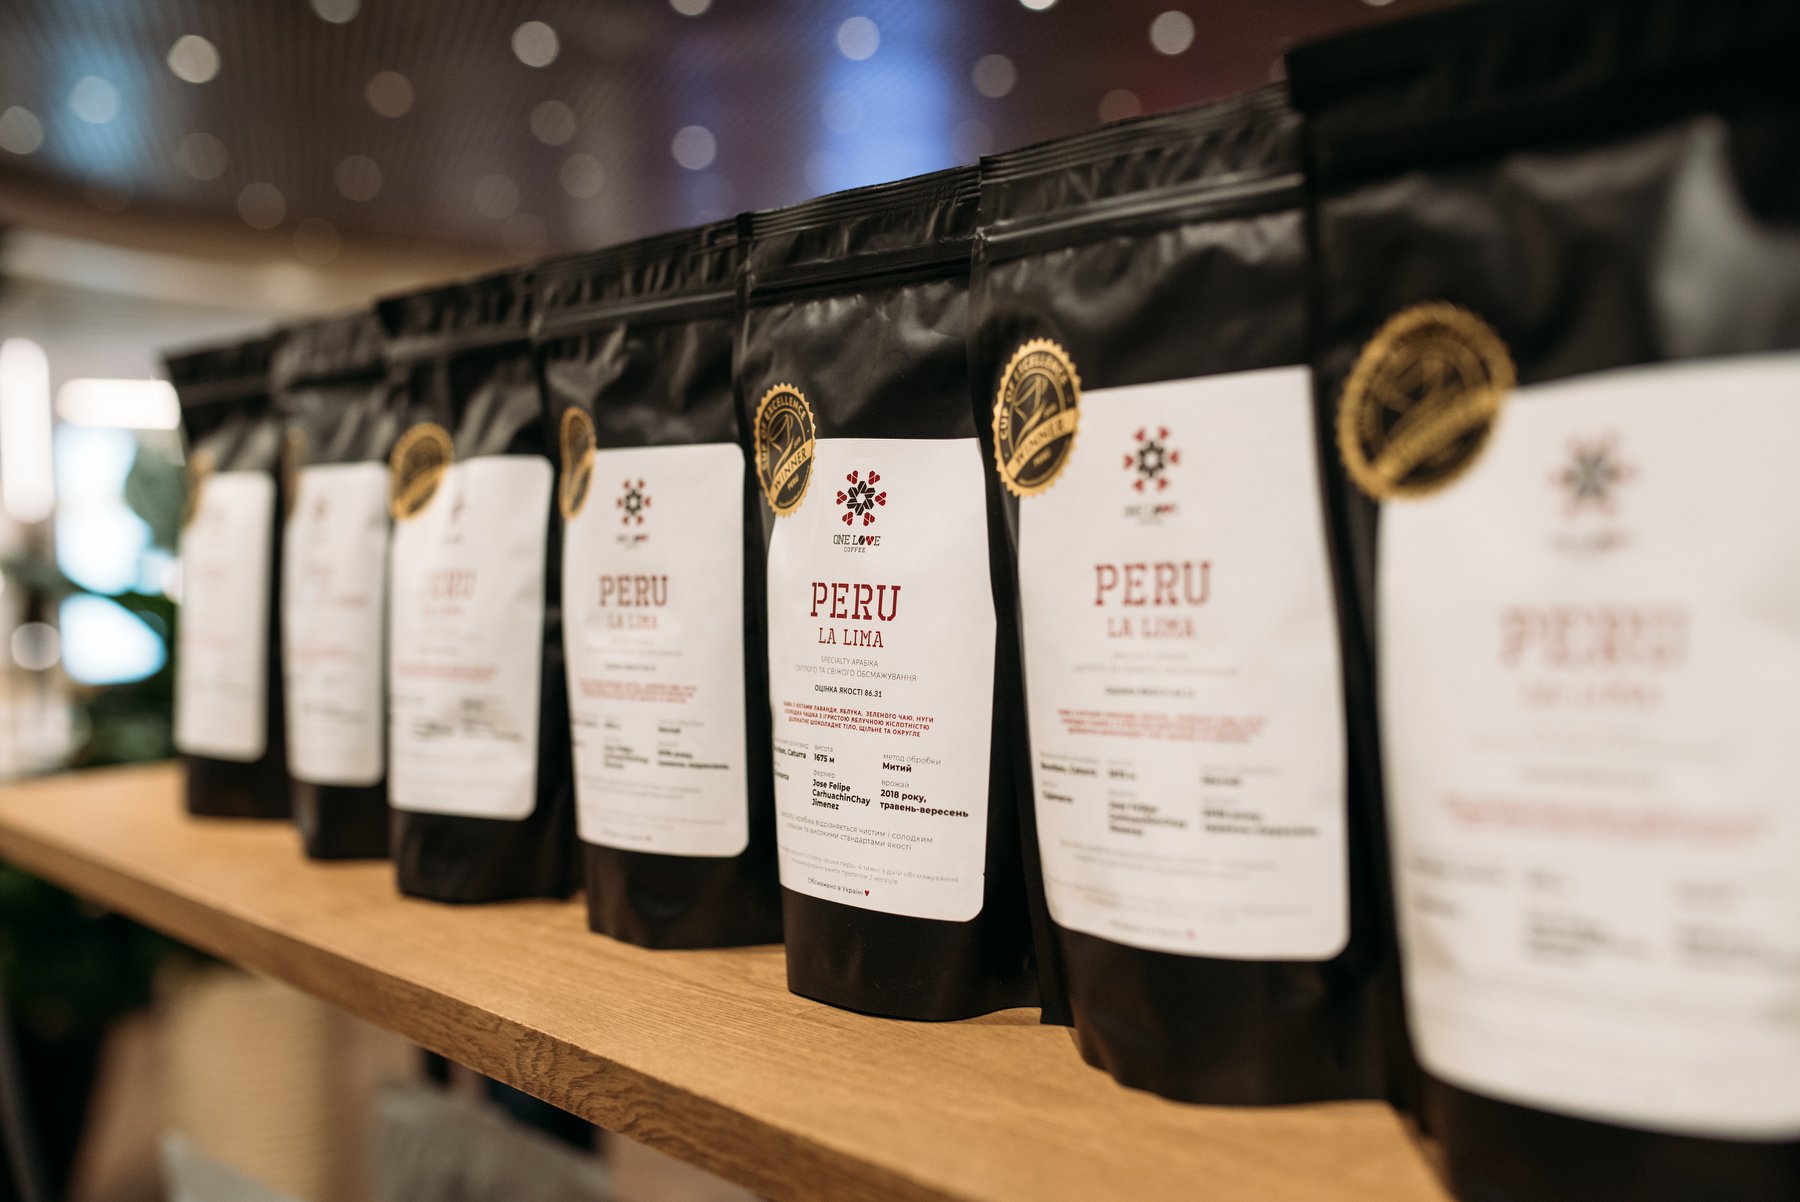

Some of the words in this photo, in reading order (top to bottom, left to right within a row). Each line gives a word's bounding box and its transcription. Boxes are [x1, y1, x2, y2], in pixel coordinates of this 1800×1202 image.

[763, 395, 807, 420] EXCELLENCE
[773, 446, 808, 490] WINNER
[833, 534, 851, 546] ONE
[852, 534, 881, 547] LOVE
[599, 574, 669, 608] PERU
[1094, 561, 1212, 607] PERU
[810, 581, 901, 622] PERU
[818, 627, 837, 645] LA
[842, 628, 884, 649] LIMA
[821, 655, 850, 666] SPECIALTY
[851, 658, 878, 668] АРАБІКА
[819, 666, 826, 675] ТА
[826, 667, 855, 678] СВІЖОГО
[856, 669, 917, 682] ОБСМАЖУВАННЯ
[814, 684, 838, 694] ОЦІНКА
[838, 686, 863, 696] ЯКОСТІ
[864, 689, 882, 698] 86.31
[839, 708, 863, 716] ЯБЛУКА,
[866, 710, 897, 719] ЗЕЛЕНОГО
[898, 714, 915, 722] ЧАЮ,
[916, 716, 934, 724] НУГИ
[851, 717, 884, 727] ЯБЛУЧНОЮ
[885, 721, 930, 731] КІСЛОТНІСТЮ
[810, 718, 841, 729] ШОКОЛАДНЕ
[859, 725, 882, 734] ЩІЛЬНЕ
[892, 729, 920, 738] ОКРУГЛЕ
[788, 748, 807, 760] Caturra
[813, 753, 828, 763] 1675
[882, 753, 905, 763] метод
[906, 755, 941, 766] обробки
[882, 761, 912, 773] Митий
[812, 778, 828, 789] Jose
[829, 781, 851, 792] Felipe
[881, 780, 910, 789] врожай
[811, 797, 840, 811] Jimenez
[812, 788, 871, 807] CarhuachinChay
[880, 788, 900, 799] 2018
[901, 792, 927, 804] року,
[880, 801, 969, 818] травень-вересень
[840, 833, 885, 848] стандартами
[887, 842, 912, 851] якості
[860, 827, 886, 838] чистим
[891, 832, 933, 844] солодким
